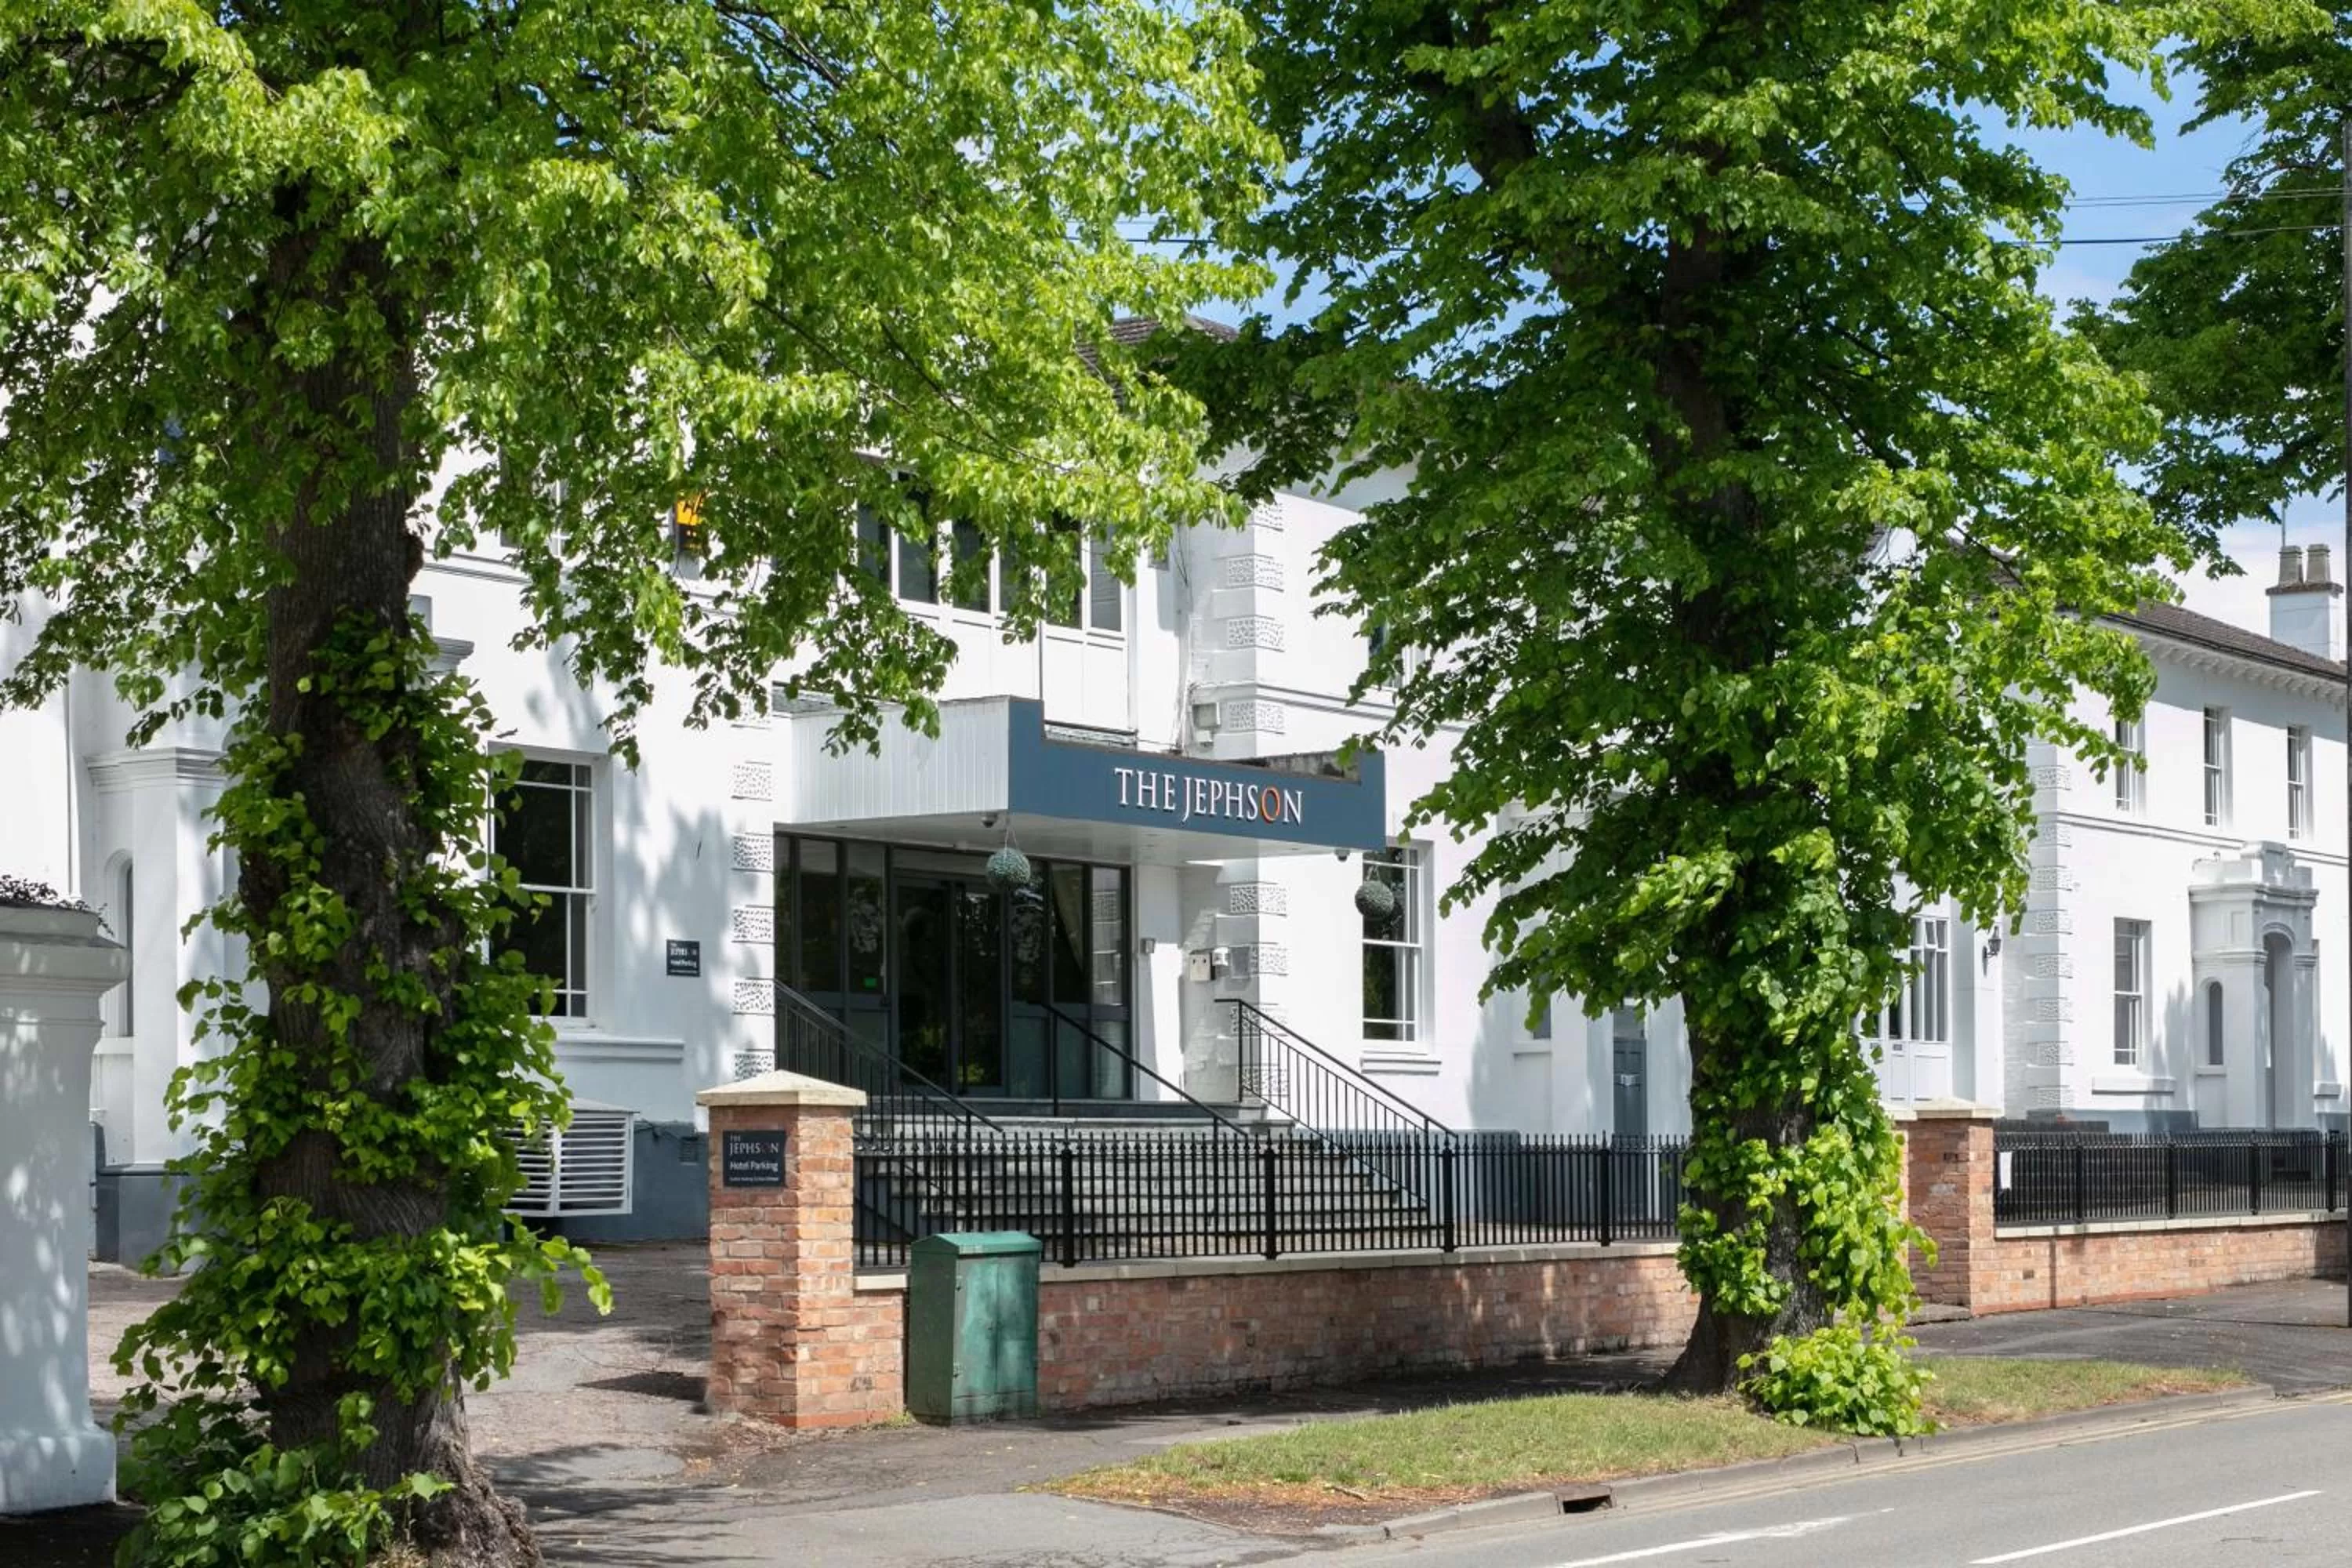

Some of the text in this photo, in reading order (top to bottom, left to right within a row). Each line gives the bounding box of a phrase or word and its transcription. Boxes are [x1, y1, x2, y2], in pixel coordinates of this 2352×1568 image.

[1114, 767, 1304, 826] THE JEPHSON
[729, 1160, 779, 1173] Hotel Parking
